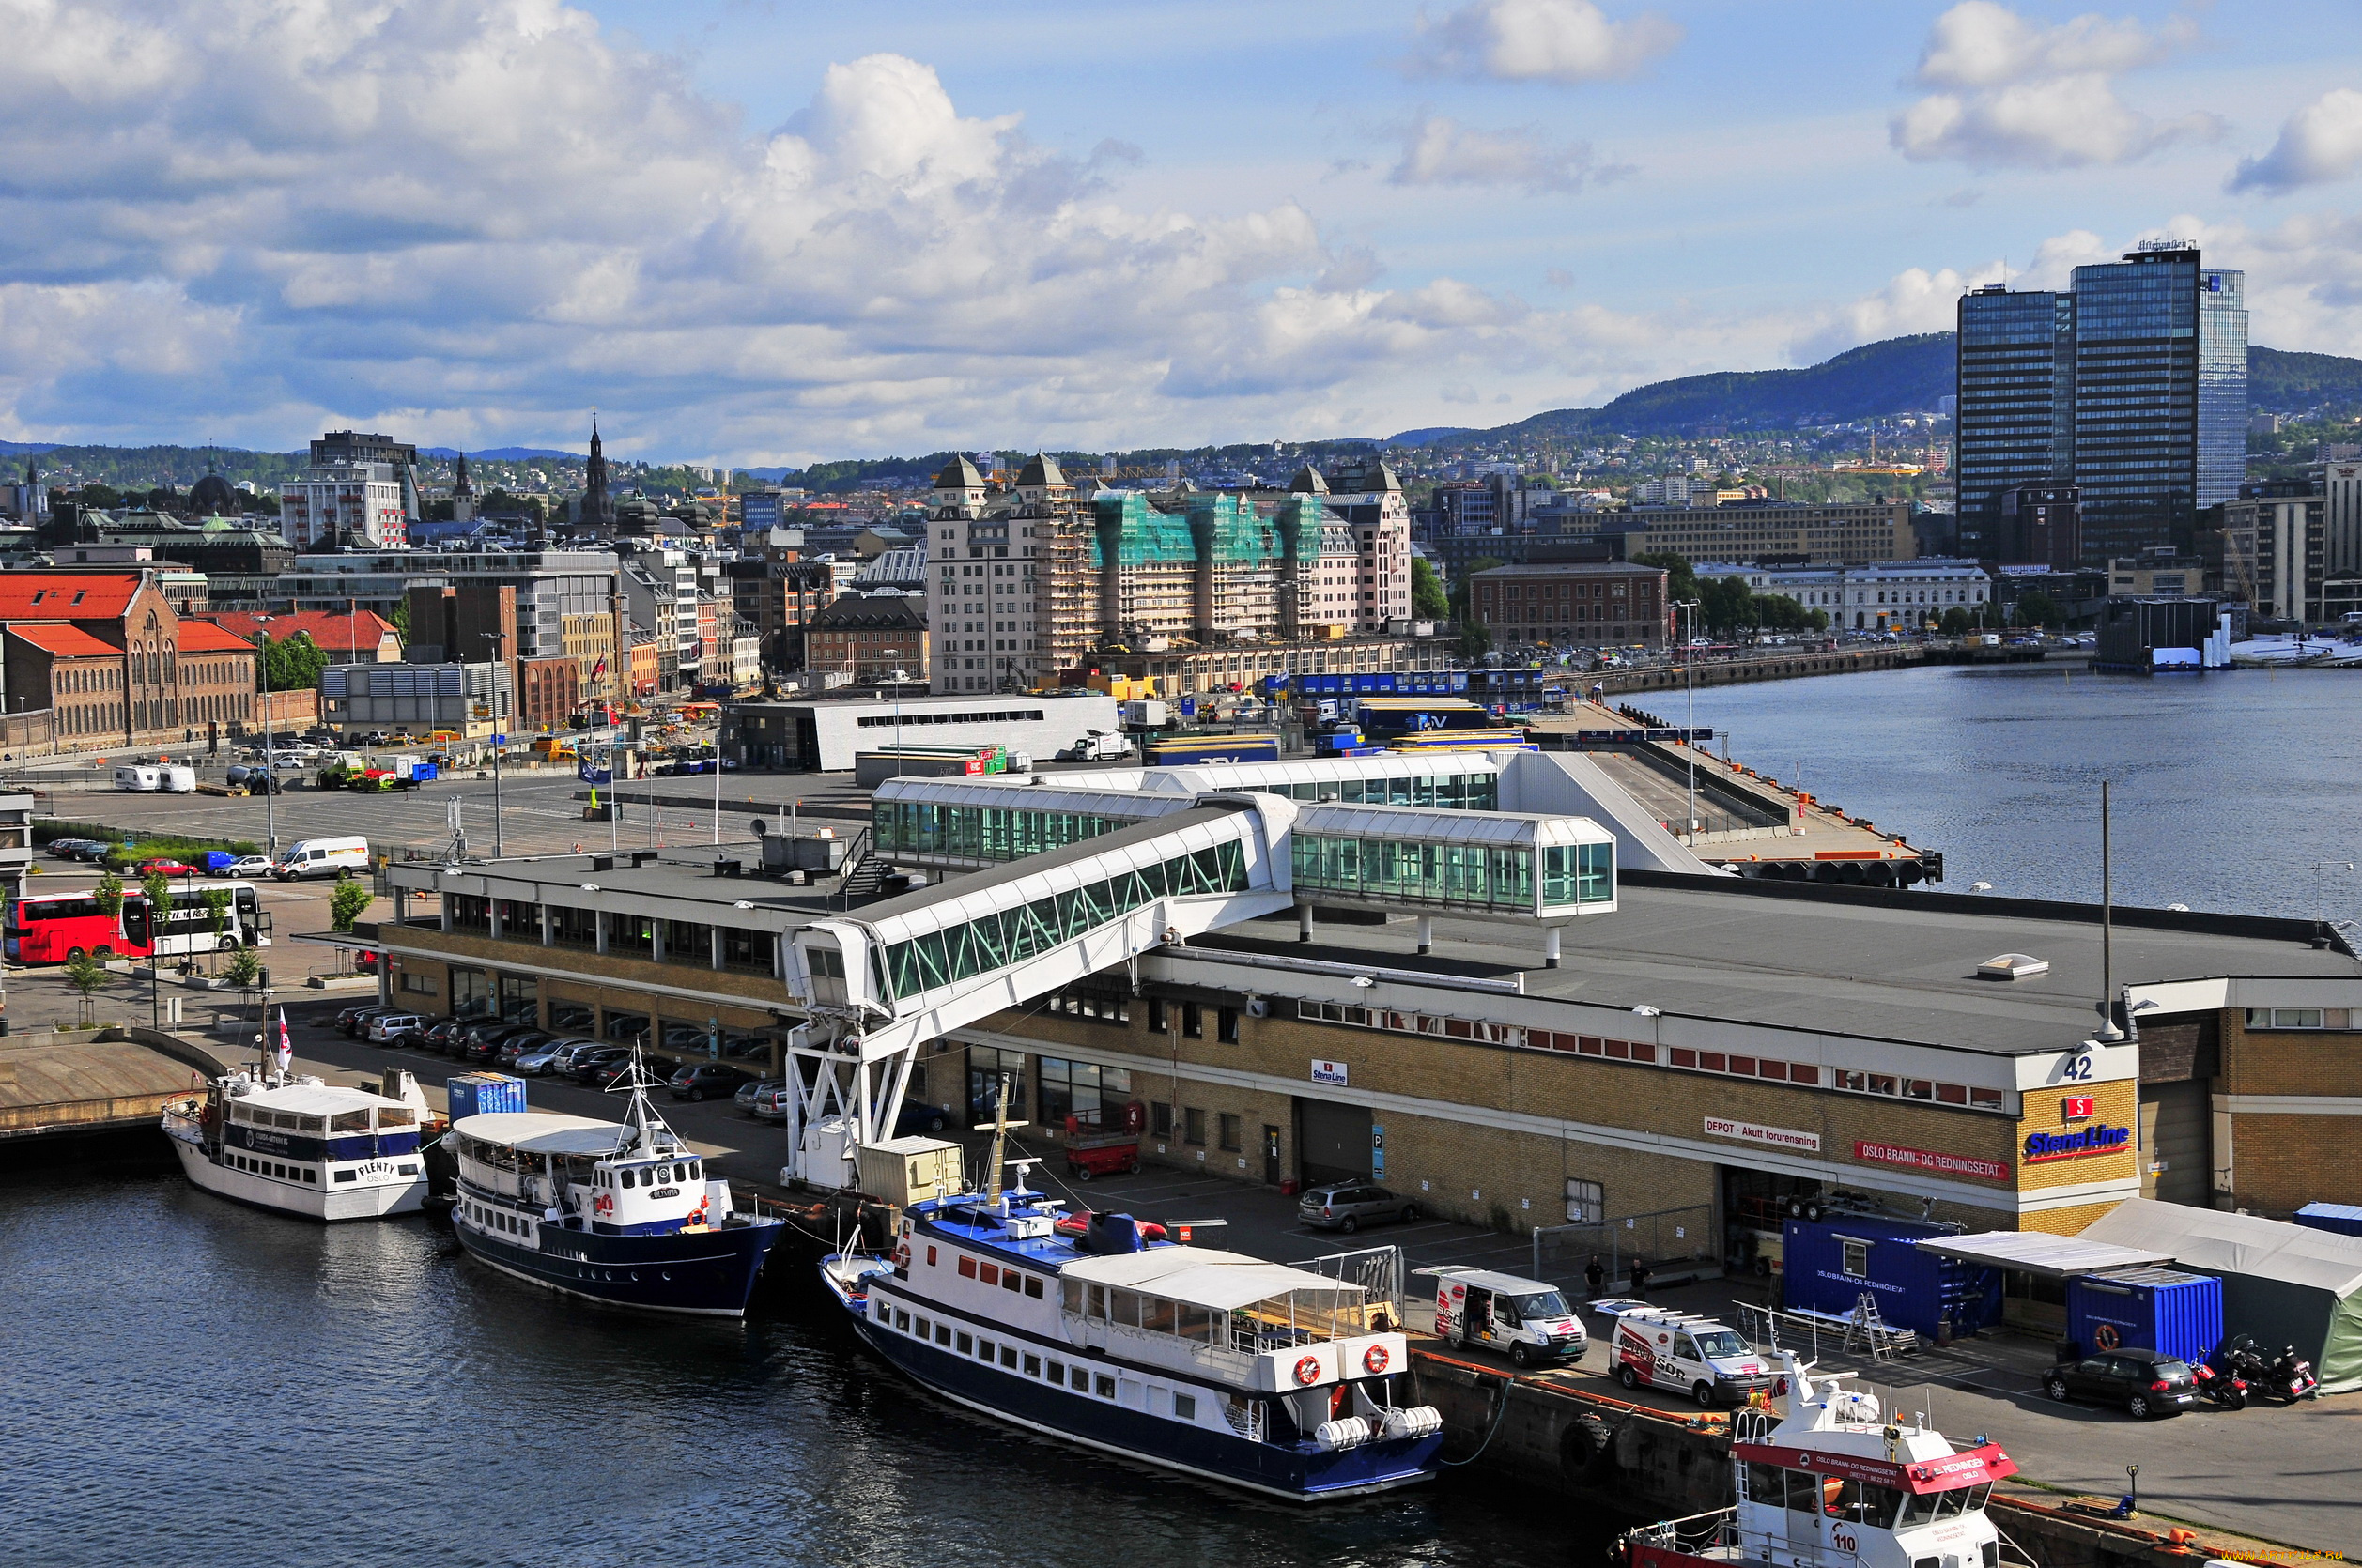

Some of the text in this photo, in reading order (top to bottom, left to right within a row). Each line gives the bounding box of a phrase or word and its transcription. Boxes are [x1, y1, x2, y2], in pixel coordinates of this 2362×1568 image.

[1313, 1069, 1346, 1083] Stena Line
[2064, 1056, 2092, 1080] 42
[2076, 1099, 2084, 1114] S
[1706, 1120, 1735, 1133] DEPOT
[1742, 1127, 1763, 1139] Akutt
[1375, 1135, 1382, 1147] P
[2030, 1124, 2129, 1154] Stena Line
[357, 1161, 395, 1176] PLENTY
[1862, 1145, 1999, 1176] OSLO BRANN- OG REDNINGSETAT
[366, 1174, 390, 1183] OSLO
[654, 1189, 678, 1199] OLYMPIA
[1815, 1455, 1898, 1477] OSLO BRANN- OG REDNINGSETAT
[1941, 1457, 1985, 1474] REDNINGEN
[1962, 1470, 1979, 1480] OSLO
[1833, 1533, 1856, 1552] 110
